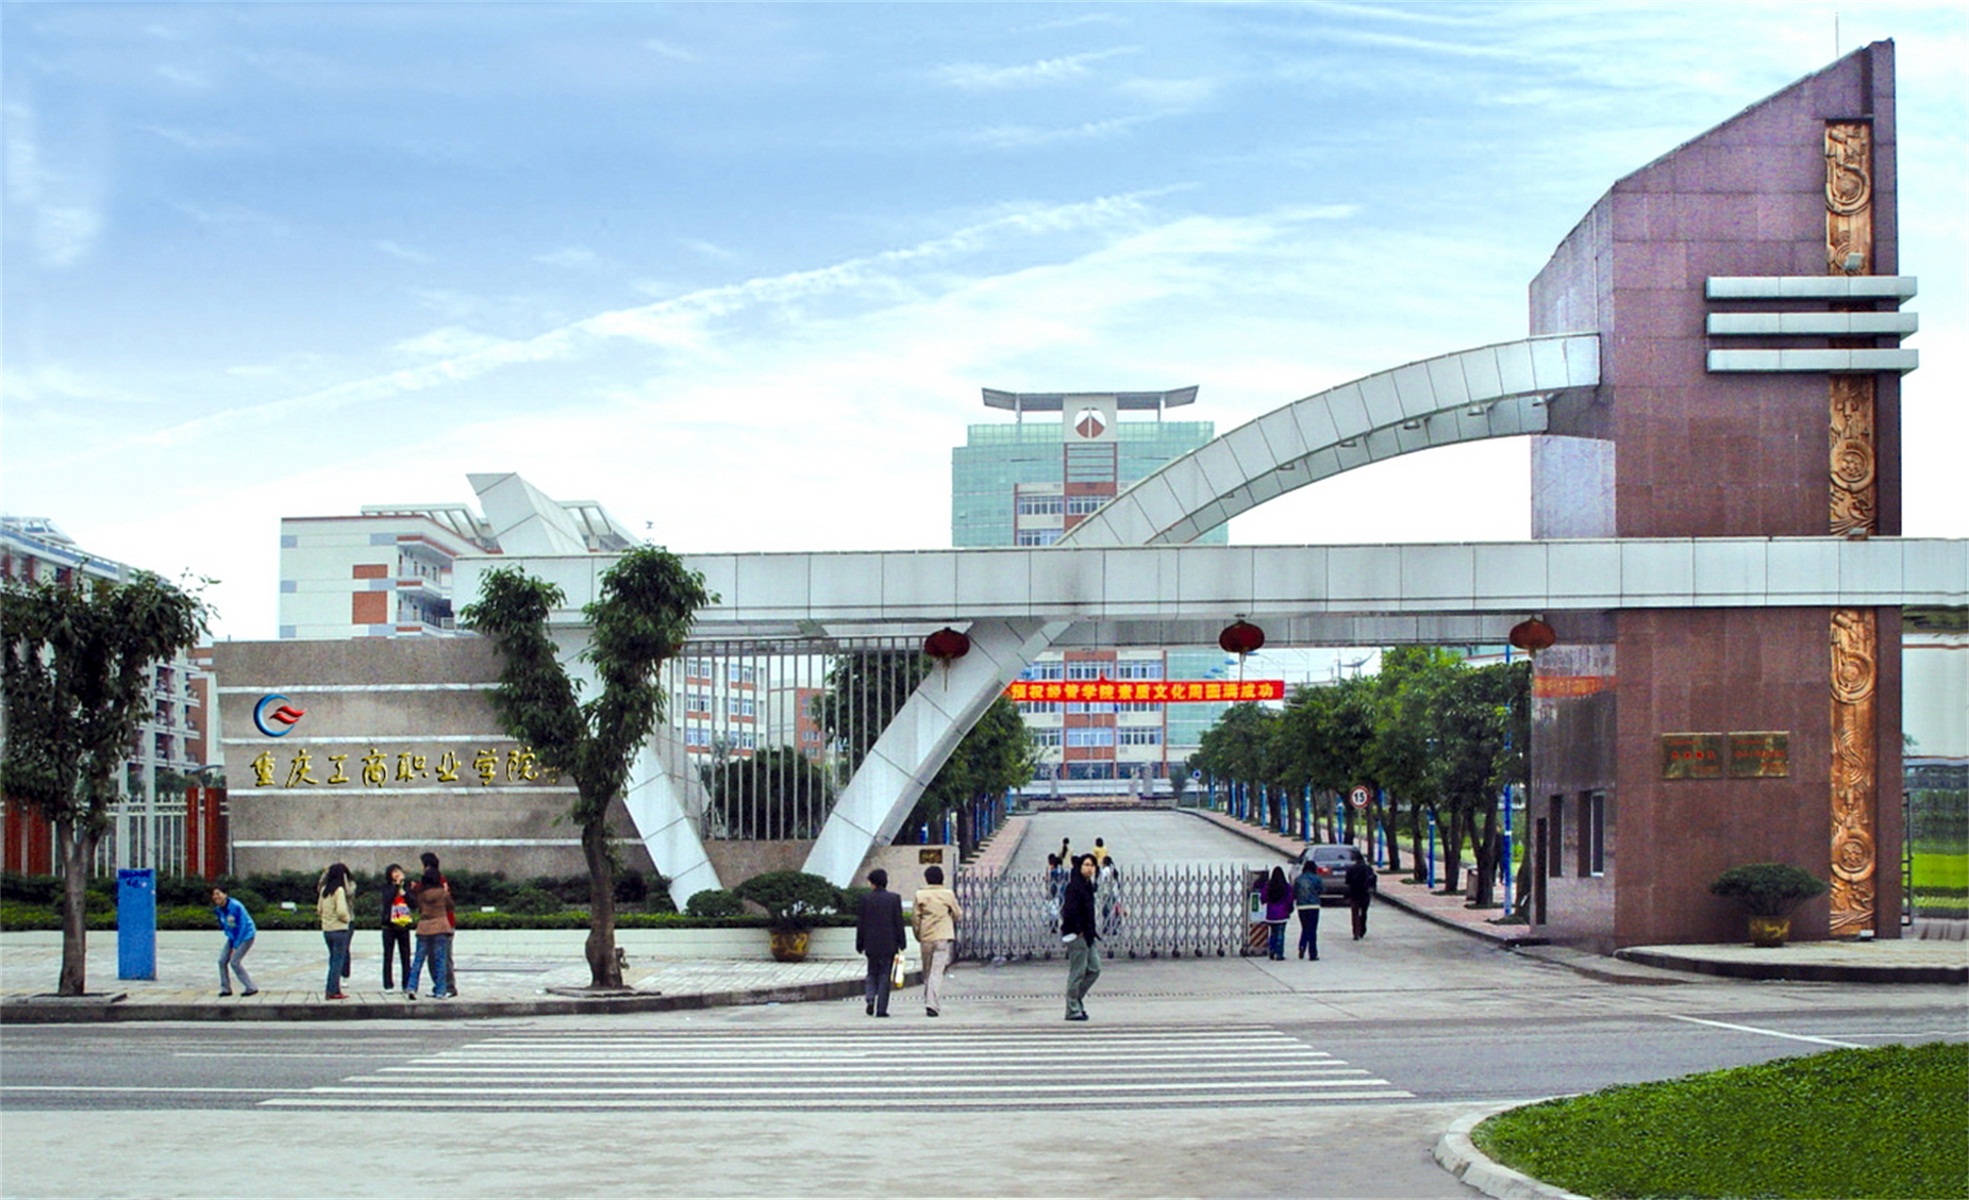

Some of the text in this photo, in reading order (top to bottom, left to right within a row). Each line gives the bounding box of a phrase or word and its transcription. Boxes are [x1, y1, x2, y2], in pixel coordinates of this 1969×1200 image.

[250, 747, 539, 788] 重庆工商职业学院
[1354, 791, 1365, 803] 15
